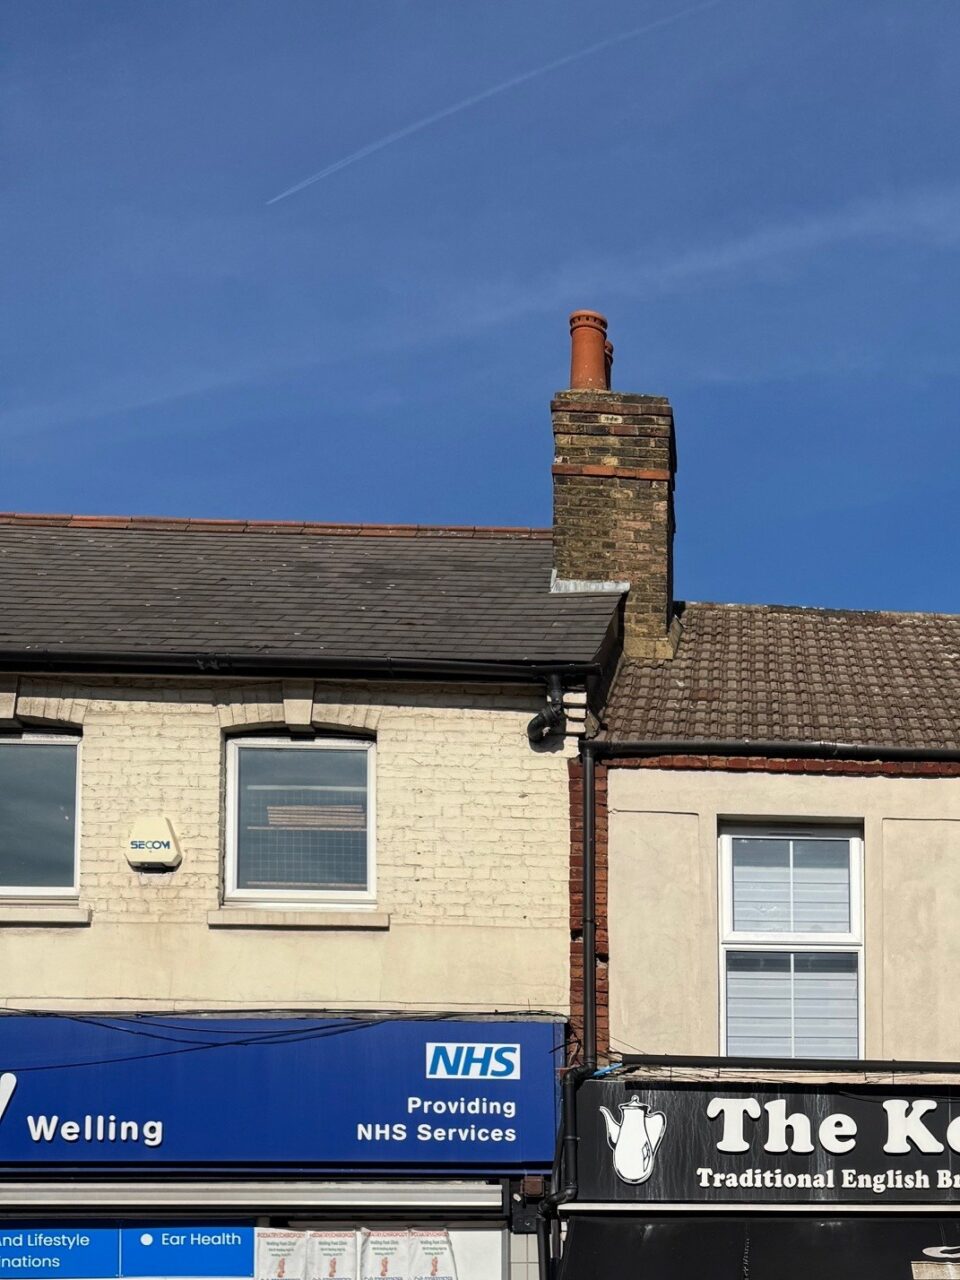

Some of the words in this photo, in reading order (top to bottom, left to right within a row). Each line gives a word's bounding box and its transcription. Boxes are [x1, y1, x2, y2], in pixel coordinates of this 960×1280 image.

[130, 841, 170, 849] SECOM
[428, 1045, 517, 1077] NHS
[407, 1097, 516, 1118] Providing
[27, 1115, 163, 1146] Welling
[357, 1124, 407, 1141] NHS
[417, 1124, 517, 1141] Services
[706, 1097, 858, 1154] The
[696, 1168, 835, 1189] Traditional
[841, 1169, 929, 1193] English
[27, 1233, 90, 1249] Lifestyle
[161, 1233, 186, 1246] Ear
[190, 1233, 242, 1246] Health
